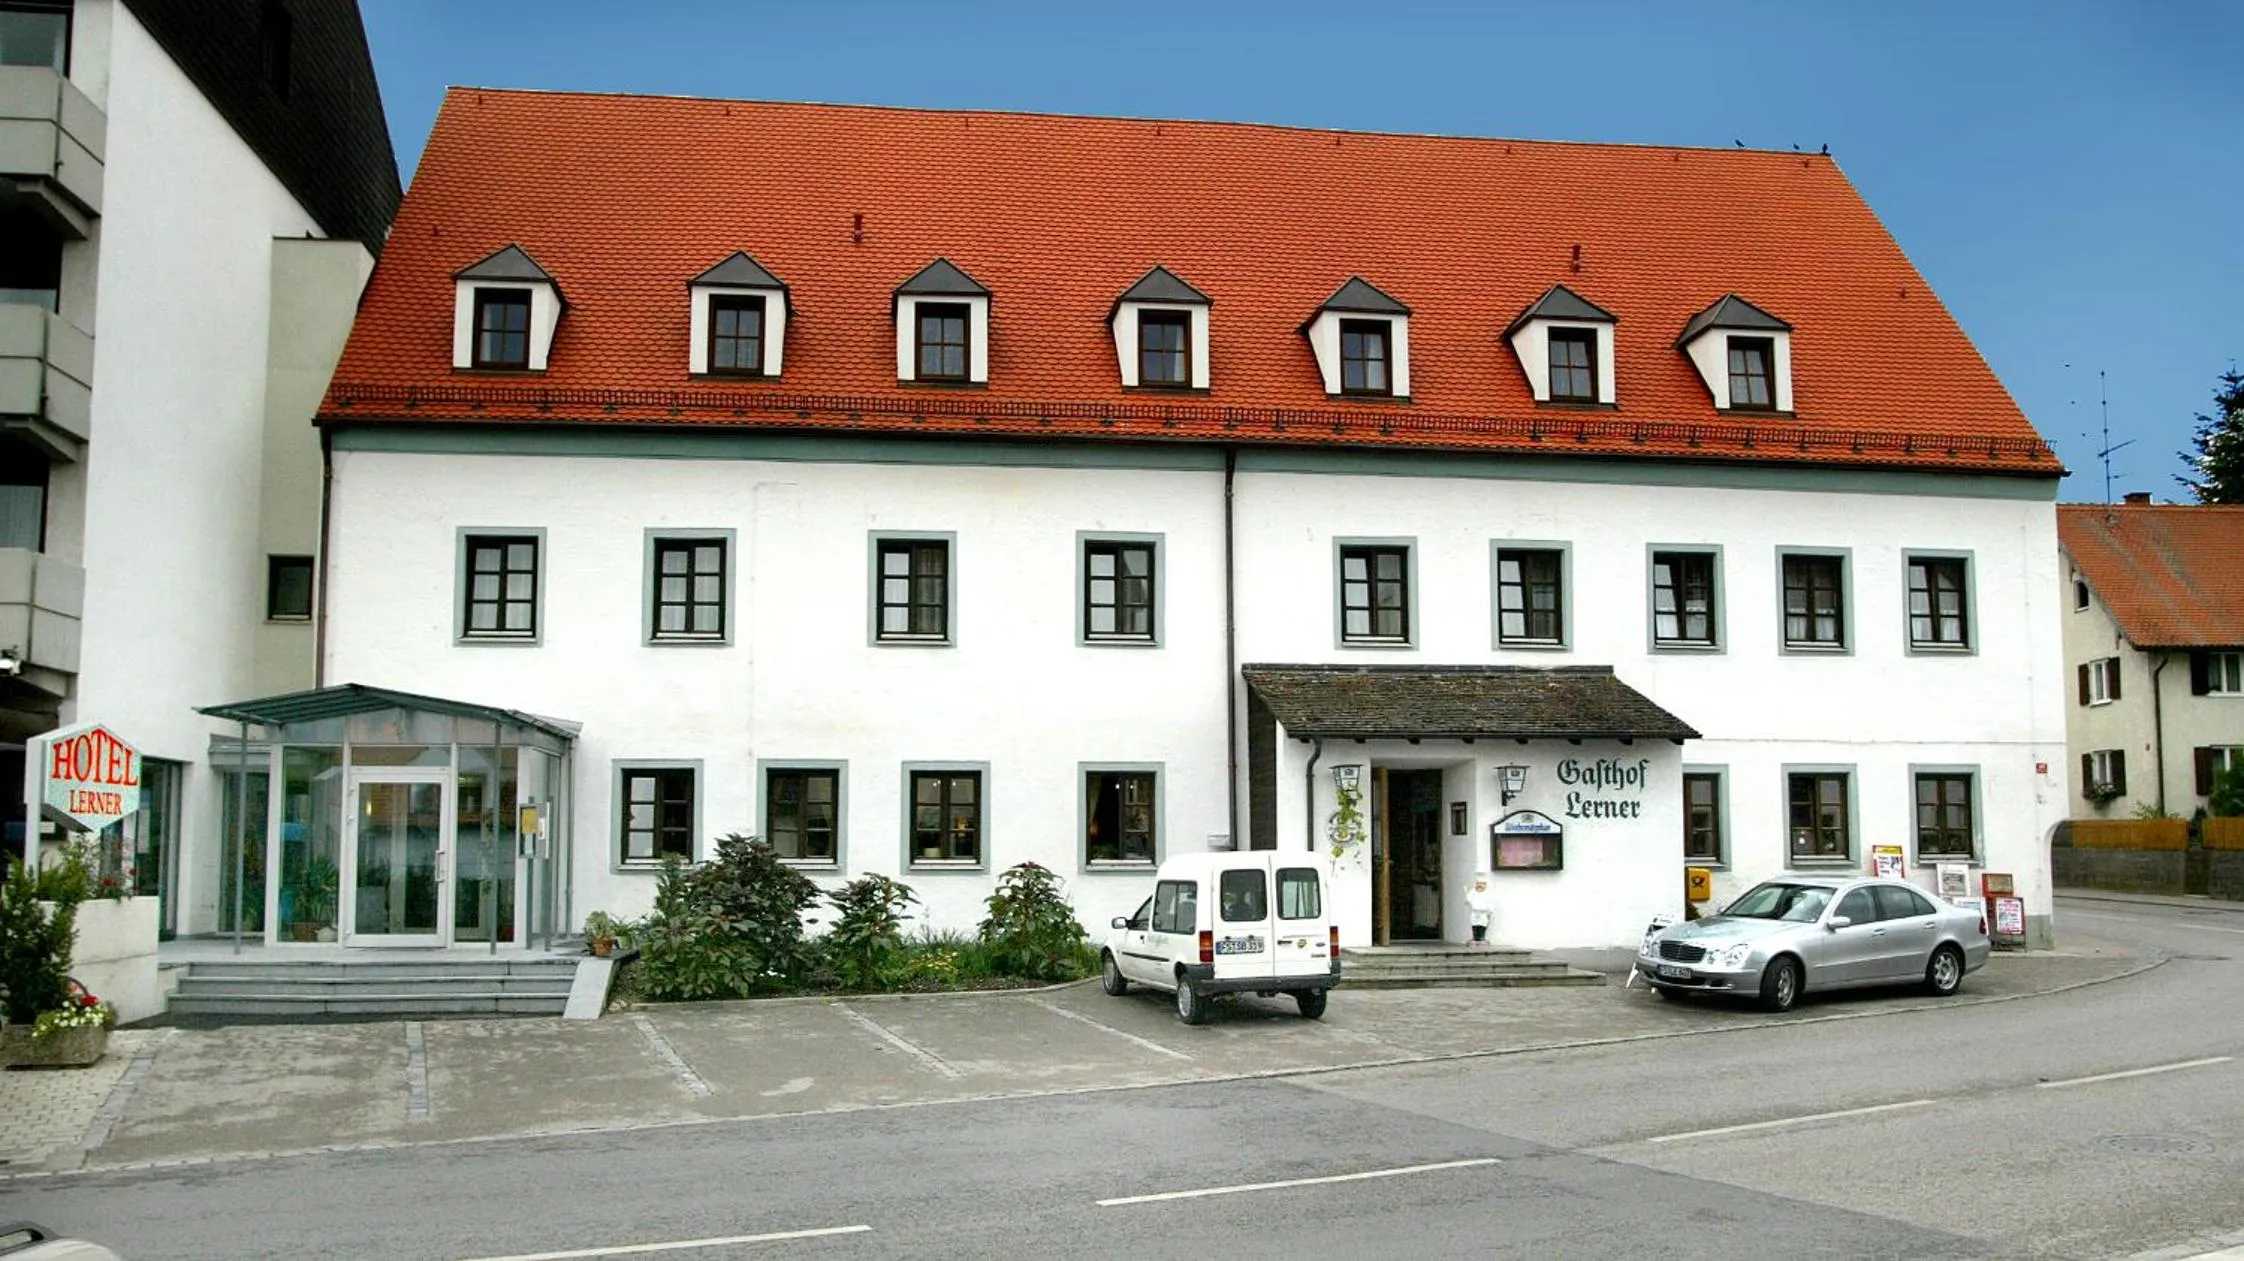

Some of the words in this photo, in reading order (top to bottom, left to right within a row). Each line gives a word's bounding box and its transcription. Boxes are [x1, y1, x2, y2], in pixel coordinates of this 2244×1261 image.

[52, 728, 138, 786] HOTEL
[1557, 758, 1649, 792] Gasthof
[70, 789, 122, 814] LERNER
[1565, 791, 1641, 818] Lerner
